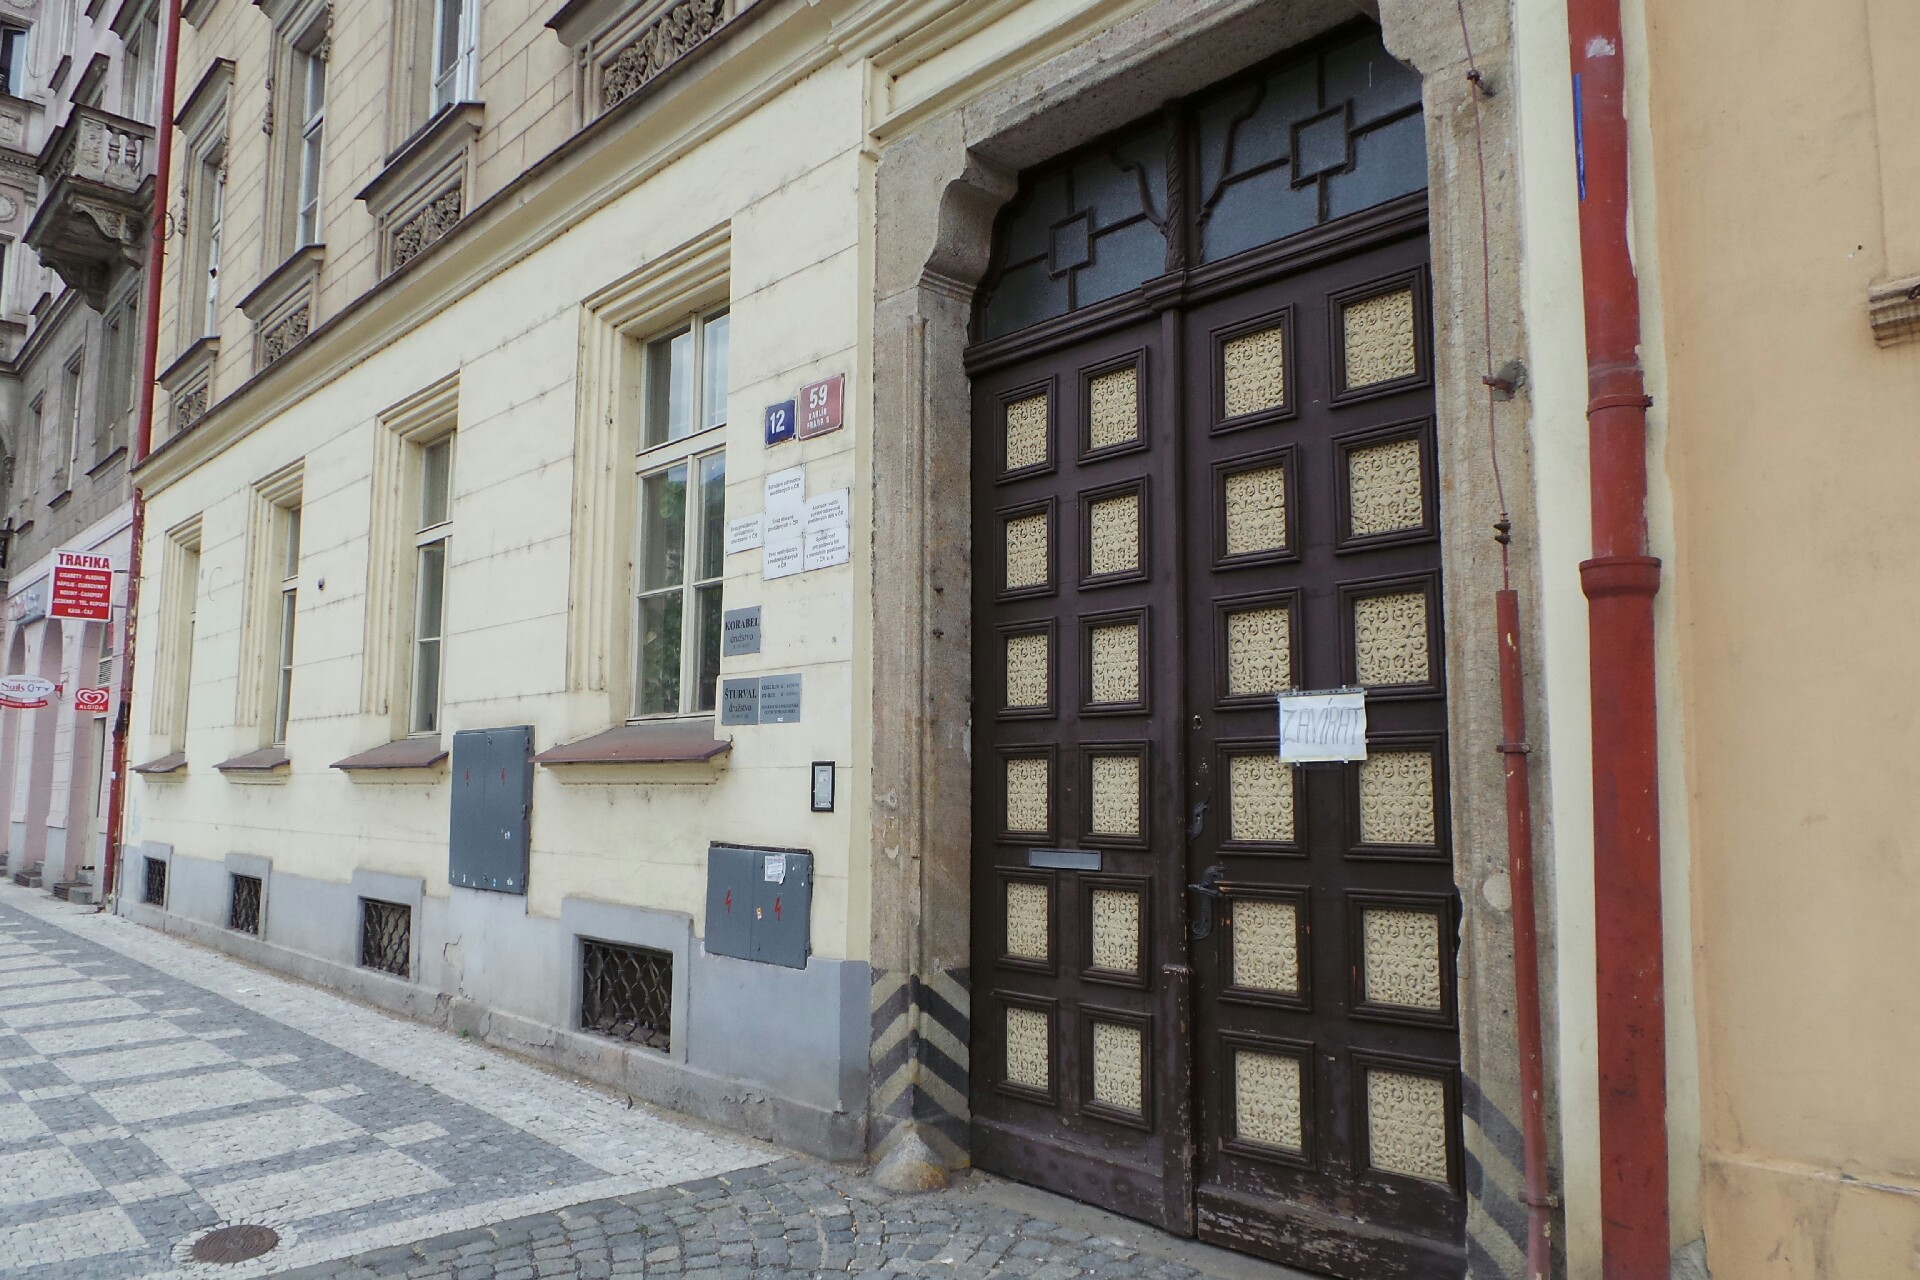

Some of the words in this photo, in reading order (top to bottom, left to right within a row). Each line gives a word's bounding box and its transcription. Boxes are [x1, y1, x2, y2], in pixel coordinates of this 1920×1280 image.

[809, 384, 828, 409] 59
[770, 409, 786, 435] 12
[806, 417, 824, 431] PRAHA
[58, 553, 110, 570] TRAFIKA
[725, 617, 760, 631] KORABEL
[724, 688, 757, 700] ŠTURVAL
[728, 704, 752, 713] družstvo
[1281, 697, 1364, 746] ZAVÍRAT
